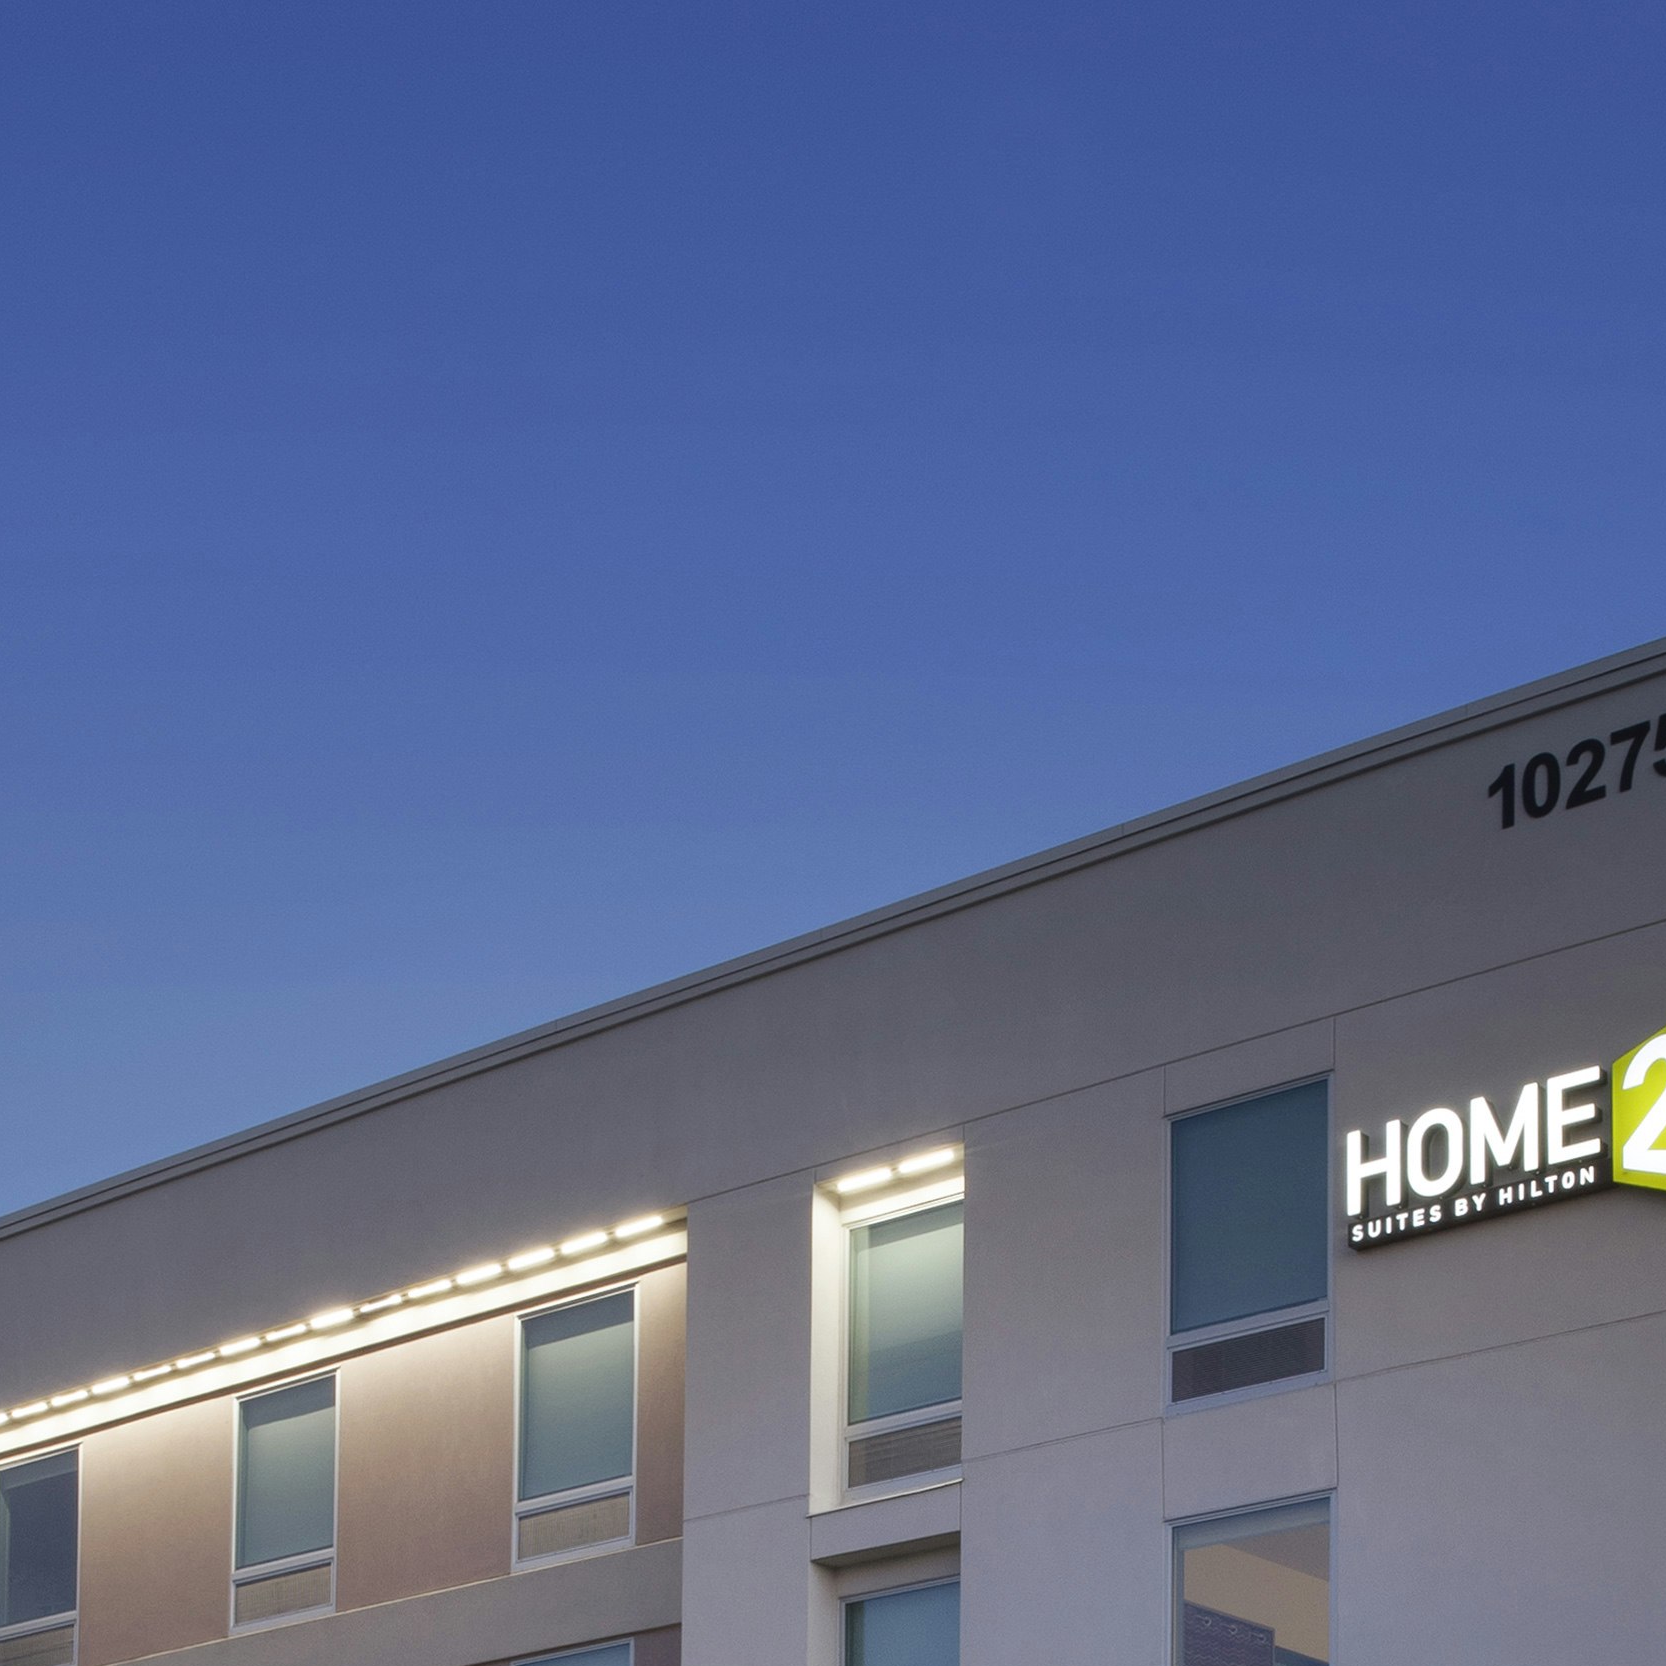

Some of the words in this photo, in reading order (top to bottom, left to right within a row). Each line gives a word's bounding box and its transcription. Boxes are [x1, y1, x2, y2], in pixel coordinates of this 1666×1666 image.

[1351, 1204, 1442, 1242] SUITES
[1454, 1192, 1486, 1217] BY
[1498, 1165, 1595, 1206] HILTON
